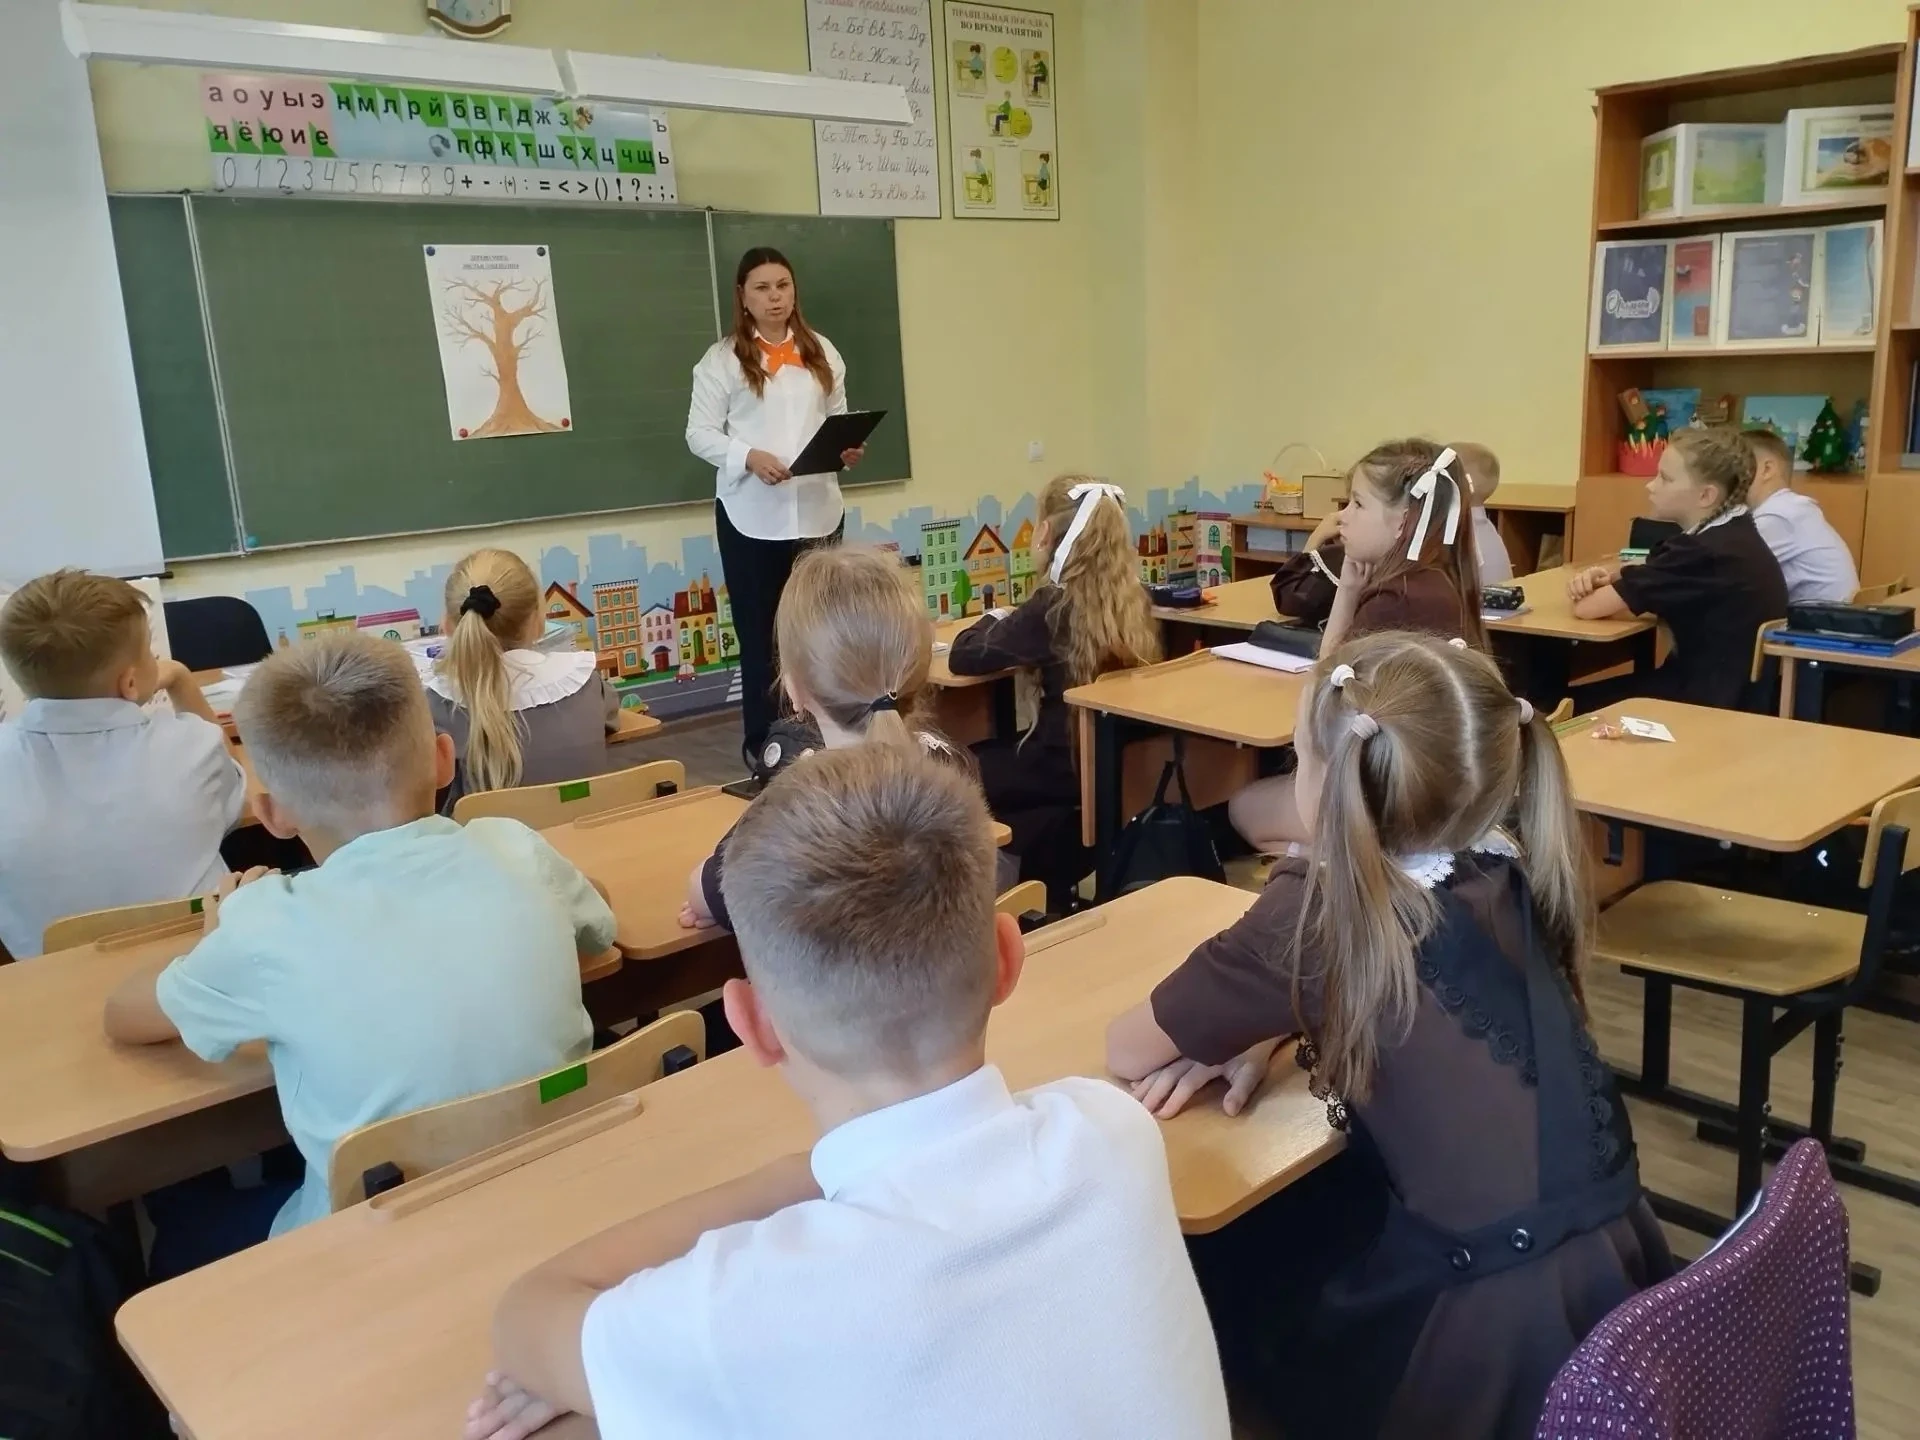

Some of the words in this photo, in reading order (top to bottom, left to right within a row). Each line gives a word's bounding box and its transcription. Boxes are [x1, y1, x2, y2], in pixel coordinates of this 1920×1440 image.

[952, 8, 1009, 23] ПРАВИЛЬНАЯ
[961, 21, 973, 30] ВО
[975, 22, 1003, 34] ВРЕМЯ
[1006, 26, 1042, 39] ЗАНЯТИЙ
[208, 86, 223, 102] а
[233, 88, 248, 103] о
[260, 89, 274, 111] у
[283, 91, 304, 108] ы
[311, 93, 324, 109] э
[337, 95, 351, 110] н
[358, 97, 374, 112] м
[383, 98, 397, 114] л
[408, 99, 421, 120] р
[429, 96, 442, 117] й
[453, 98, 467, 119] б
[474, 105, 487, 120] в
[498, 106, 507, 121] г
[517, 108, 532, 126] д
[535, 109, 551, 125] ж
[559, 112, 569, 126] з
[213, 125, 228, 141] я
[239, 121, 253, 142] ё
[262, 127, 283, 143] ю
[292, 129, 305, 144] и
[315, 129, 329, 146] е
[457, 138, 470, 154] п
[474, 135, 494, 159] ф
[500, 141, 513, 157] к
[521, 143, 533, 158] т
[539, 144, 555, 159] ш
[563, 145, 575, 160] с
[582, 146, 594, 161] х
[602, 147, 615, 165] ц
[222, 157, 237, 188] 0
[255, 159, 262, 191] 1
[277, 158, 292, 190] 2
[302, 160, 314, 191] 3
[323, 160, 337, 191] 4
[349, 162, 359, 193] 5
[372, 163, 383, 194] 6
[421, 166, 431, 196] 8
[443, 167, 455, 197] 9
[631, 178, 641, 201] ?
